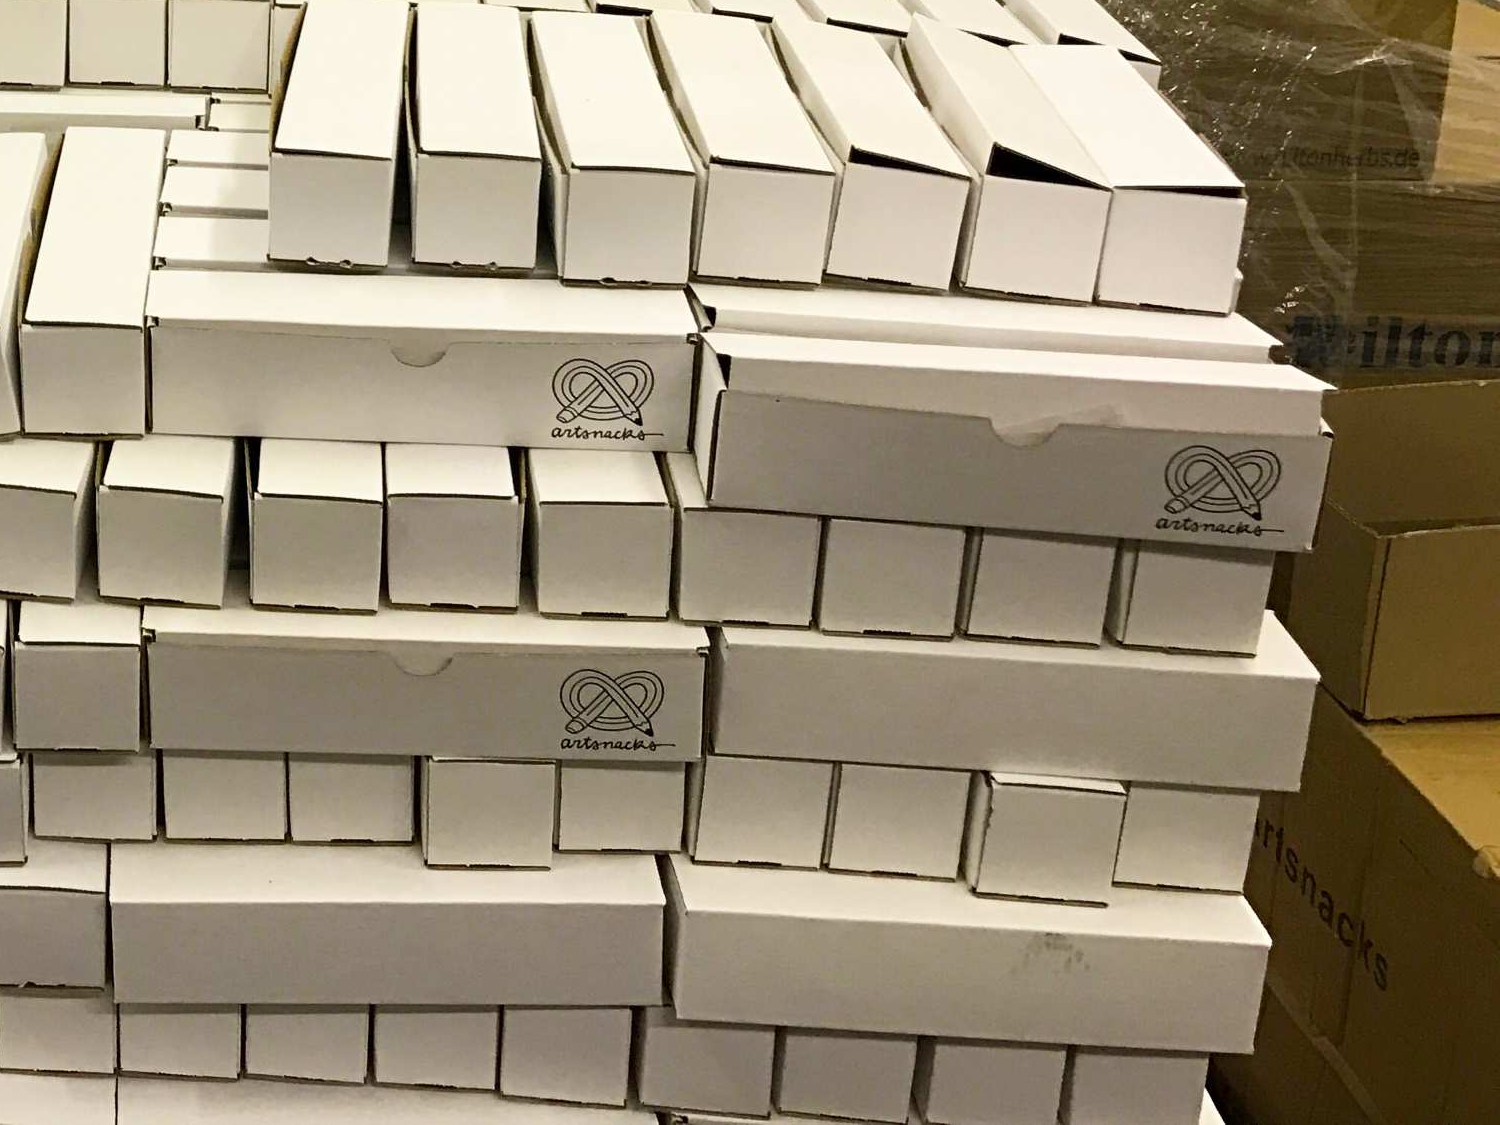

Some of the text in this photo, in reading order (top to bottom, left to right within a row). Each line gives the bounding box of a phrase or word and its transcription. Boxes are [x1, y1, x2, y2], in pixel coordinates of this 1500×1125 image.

[551, 426, 664, 441] artsnacks
[1155, 517, 1285, 537] artsnacks
[560, 736, 676, 752] artsnacks
